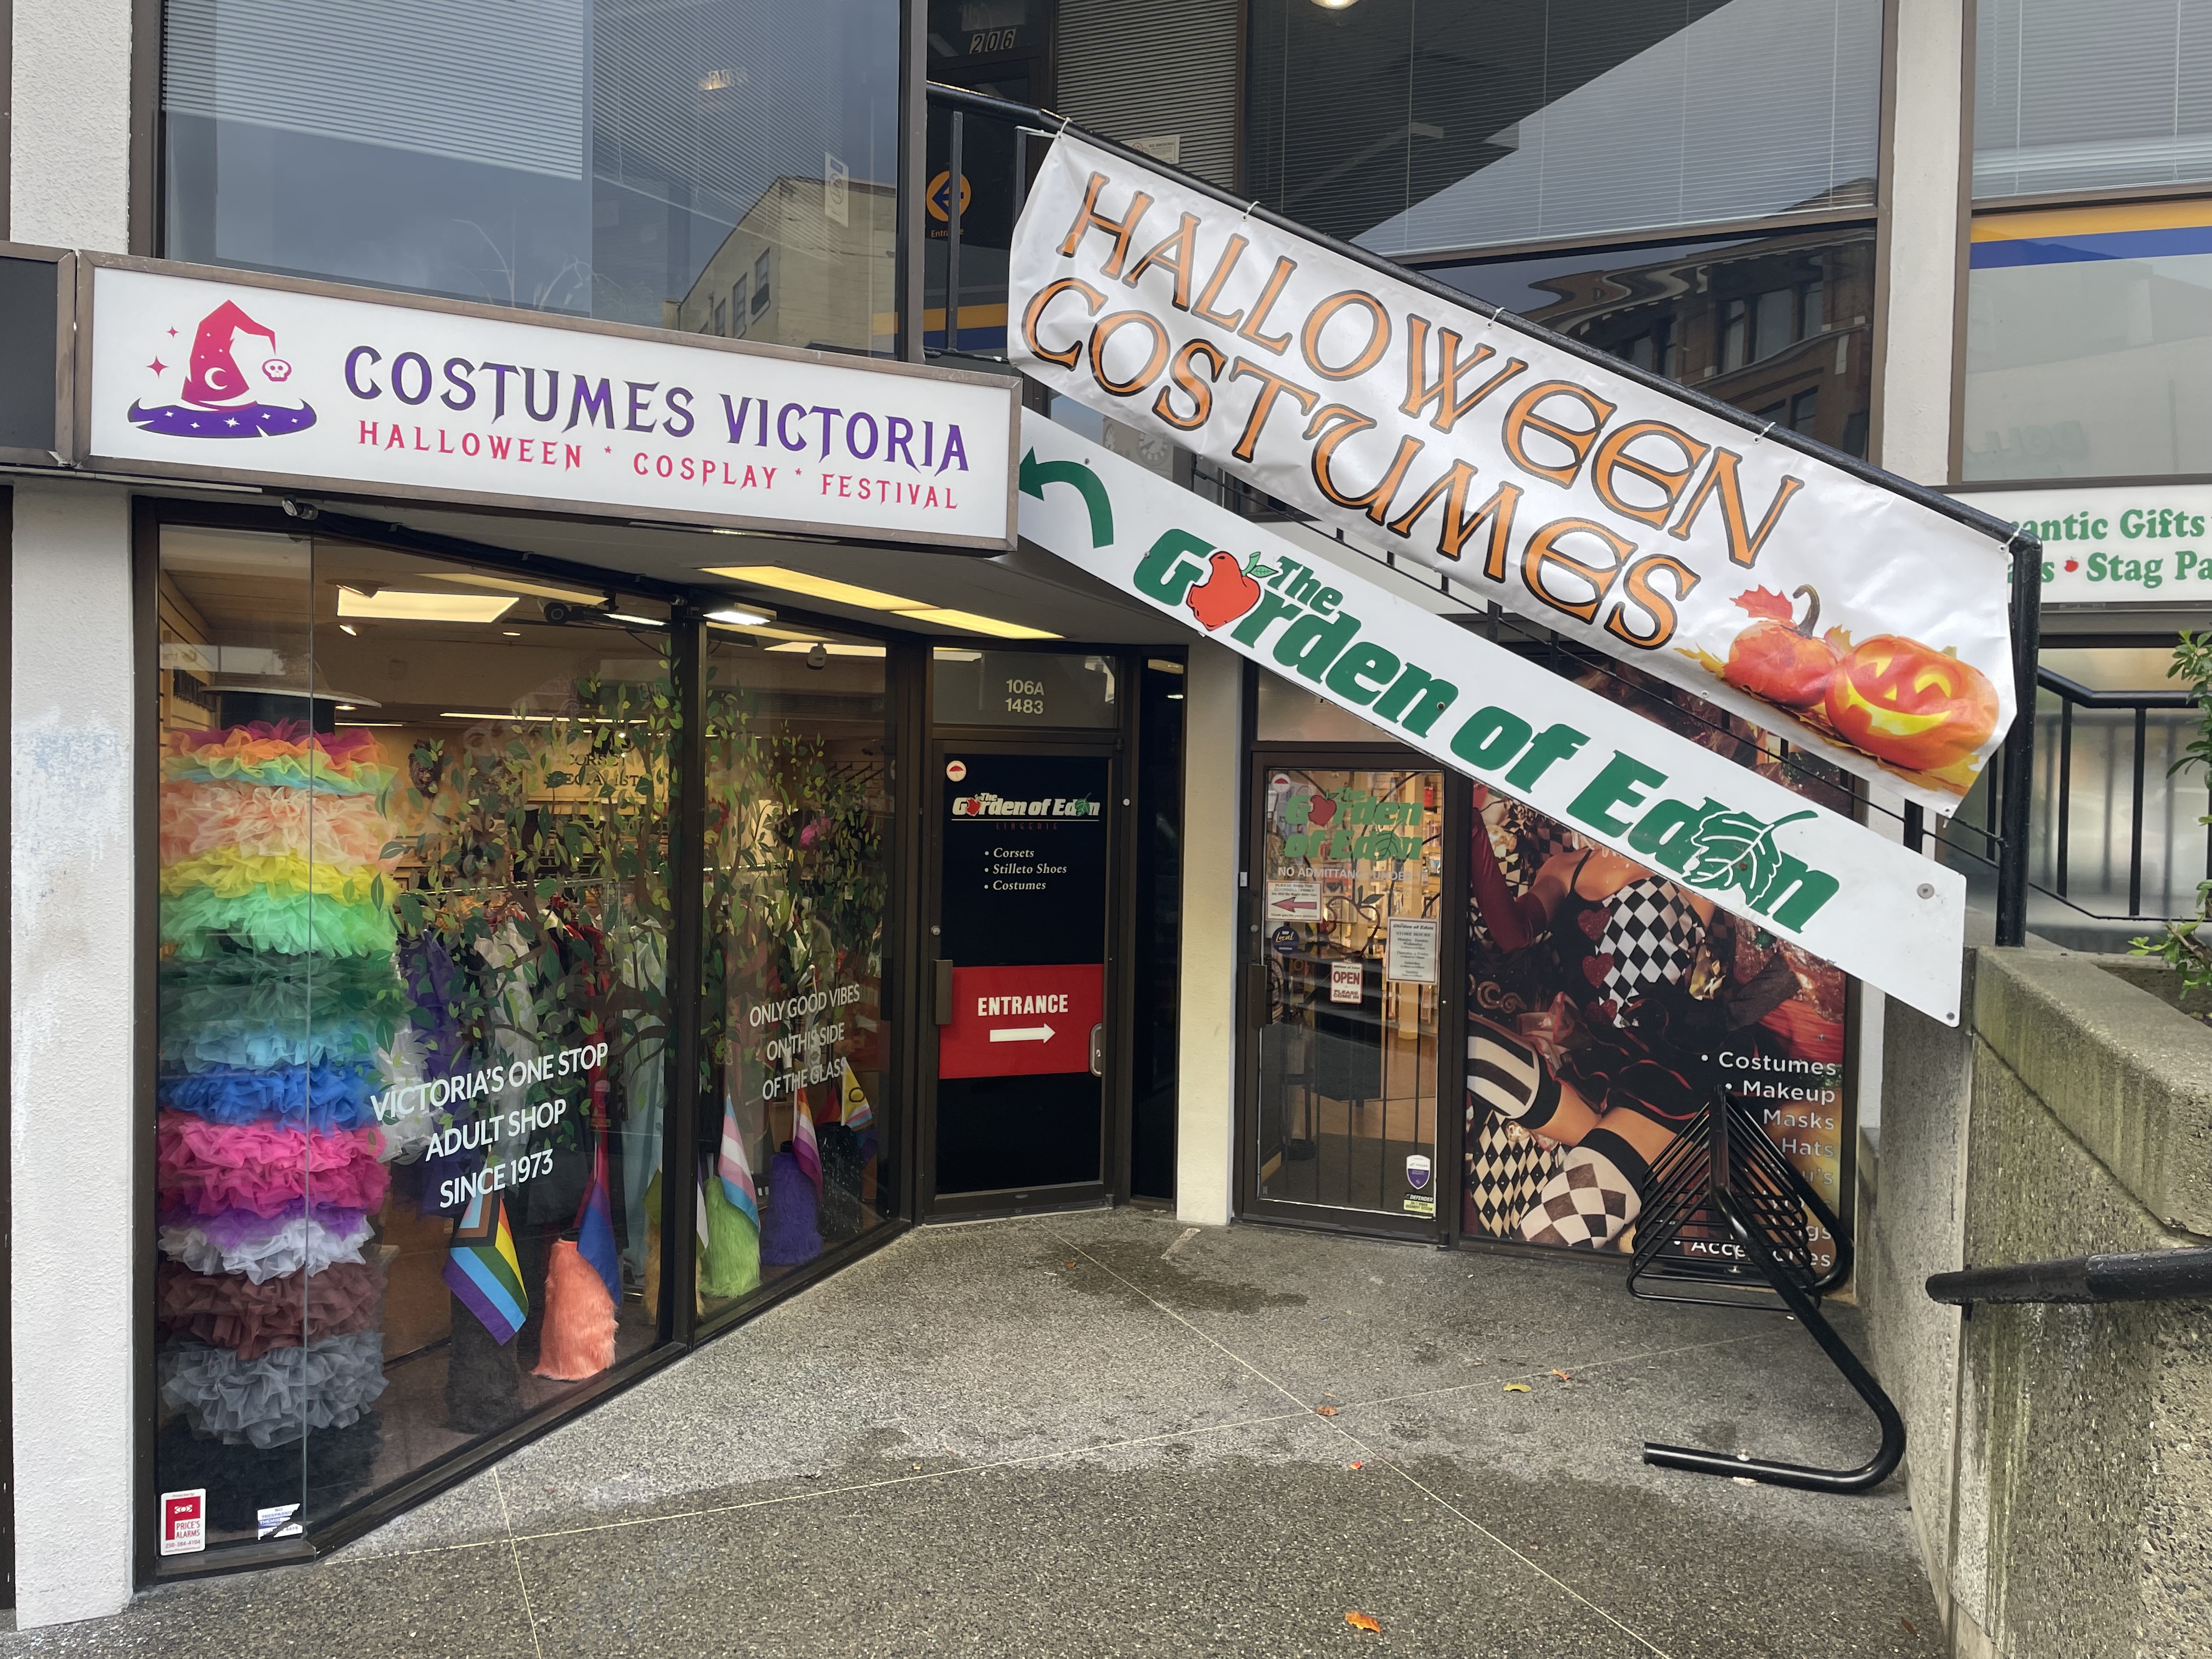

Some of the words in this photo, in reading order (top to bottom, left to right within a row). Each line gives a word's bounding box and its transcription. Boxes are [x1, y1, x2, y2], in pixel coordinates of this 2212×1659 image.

[970, 30, 1014, 54] 206
[931, 229, 964, 238] Entre
[1056, 171, 1805, 569] HALLOWEEN
[344, 345, 696, 438] COSTUMES
[719, 392, 970, 476] VICTORIA
[358, 419, 583, 471] HALLOWEEN
[634, 452, 777, 489] COSPLAY
[821, 472, 959, 511] FESTIVAL
[1021, 277, 1702, 651] COSTUMES
[2010, 511, 2108, 541] antic
[2119, 509, 2205, 539] Gifts
[2086, 552, 2164, 589] Stag
[1265, 555, 1344, 617] The
[1449, 705, 1591, 794] of
[1006, 679, 1045, 696] 106A
[1005, 698, 1044, 714] 1483
[980, 792, 997, 802] The
[1028, 798, 1051, 816] of
[1336, 786, 1365, 800] The
[993, 847, 1035, 859] Corsets
[1285, 830, 1328, 858] of
[992, 863, 1034, 874] Stilleto
[1036, 863, 1067, 874] Shoes
[1278, 866, 1295, 877] NO
[993, 880, 1046, 891] Costumes
[1276, 931, 1295, 943] Local
[1333, 970, 1360, 985] OPEN
[749, 1000, 786, 1027] ONLY
[787, 992, 827, 1018] GOOD
[829, 983, 860, 1008] VIBES
[978, 994, 1069, 1016] ENTRANCE
[766, 1037, 787, 1061] ON
[788, 1031, 817, 1054] THIS
[820, 1022, 845, 1046] SIDE
[1718, 1051, 1837, 1076] Costumes
[370, 1066, 504, 1122] VICTORIA'S
[508, 1054, 554, 1088] ONE
[558, 1042, 609, 1077] STOP
[762, 1076, 781, 1101] OF
[783, 1068, 808, 1093] THE
[810, 1057, 847, 1085] GLASS
[1743, 1080, 1836, 1105] Makeup
[425, 1114, 505, 1162] ADULT
[508, 1098, 567, 1137] SHOP
[1763, 1109, 1835, 1131] Masks
[1781, 1138, 1834, 1158] Hats
[439, 1163, 506, 1209] SINCE
[510, 1148, 554, 1186] 1973
[1409, 1194, 1434, 1203] DEFENDER
[176, 1521, 200, 1531] PRICE'S
[176, 1529, 200, 1538] ALARMS
